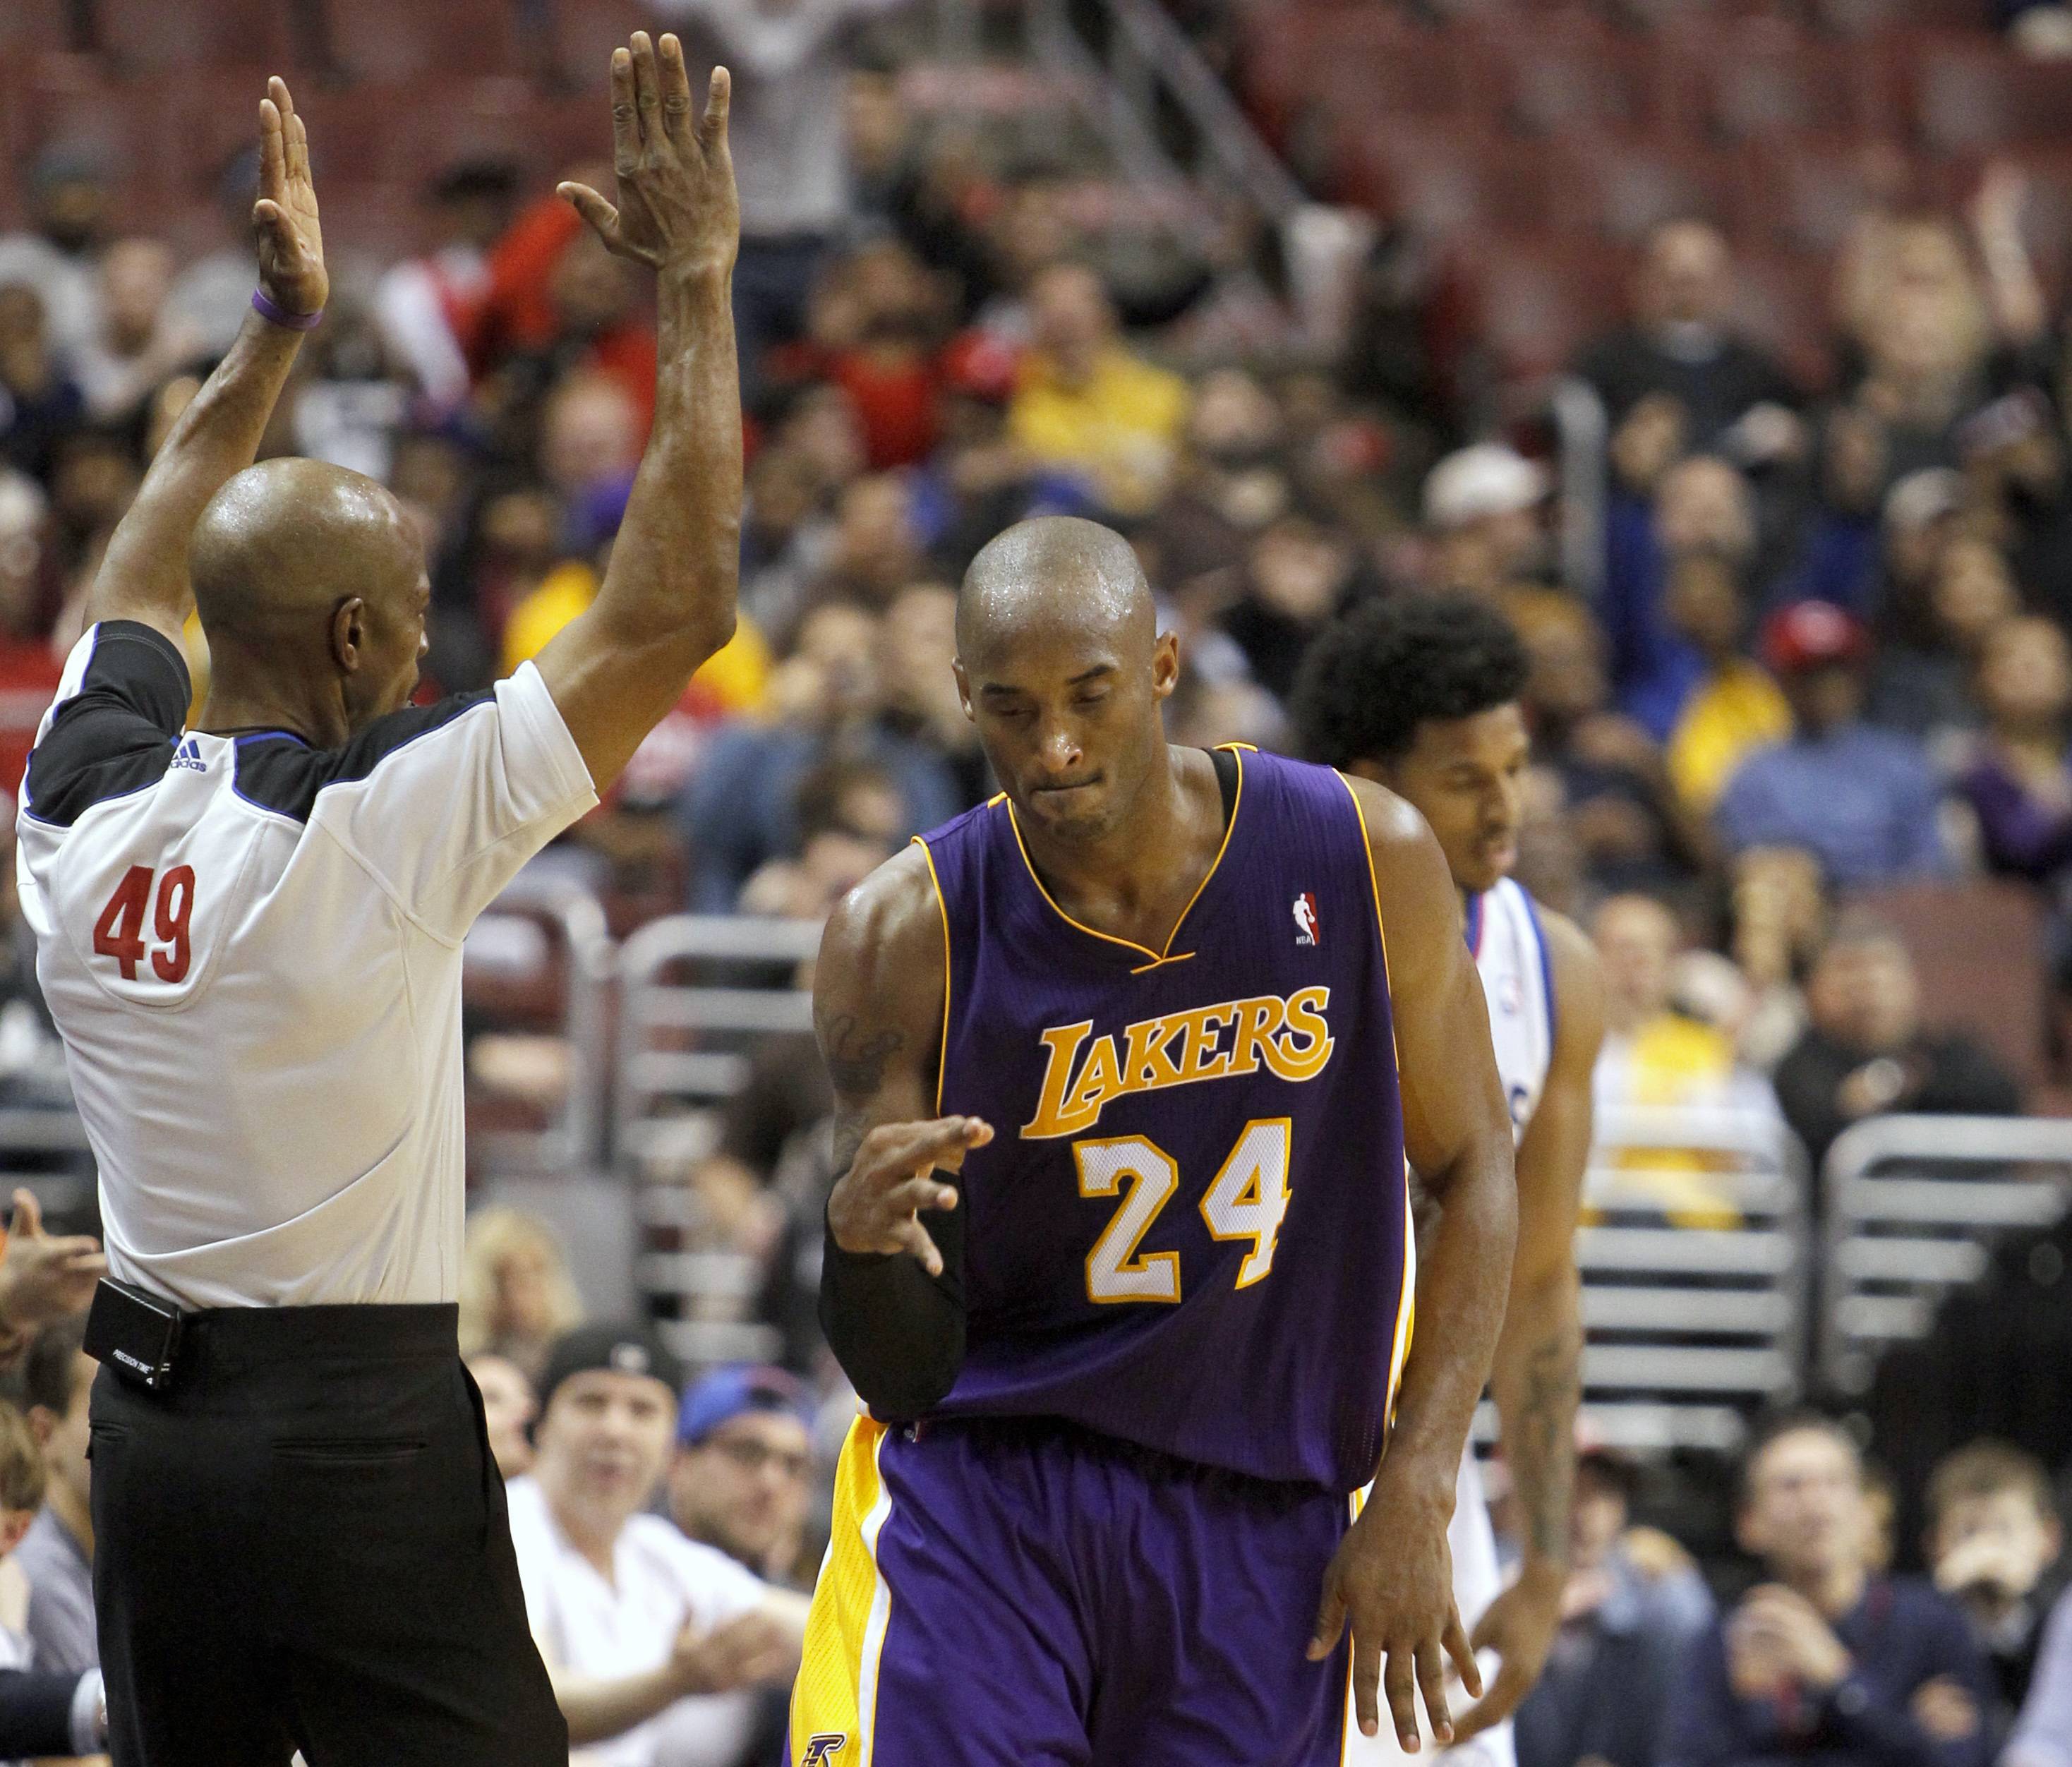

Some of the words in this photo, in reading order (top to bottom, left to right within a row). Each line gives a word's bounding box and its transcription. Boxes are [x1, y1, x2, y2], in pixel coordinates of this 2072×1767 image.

[93, 864, 195, 984] 49
[1296, 935, 1311, 945] NBA
[1018, 986, 1335, 1139] LAKERS
[1071, 1116, 1293, 1303] 24
[113, 1349, 140, 1368] PRECISION
